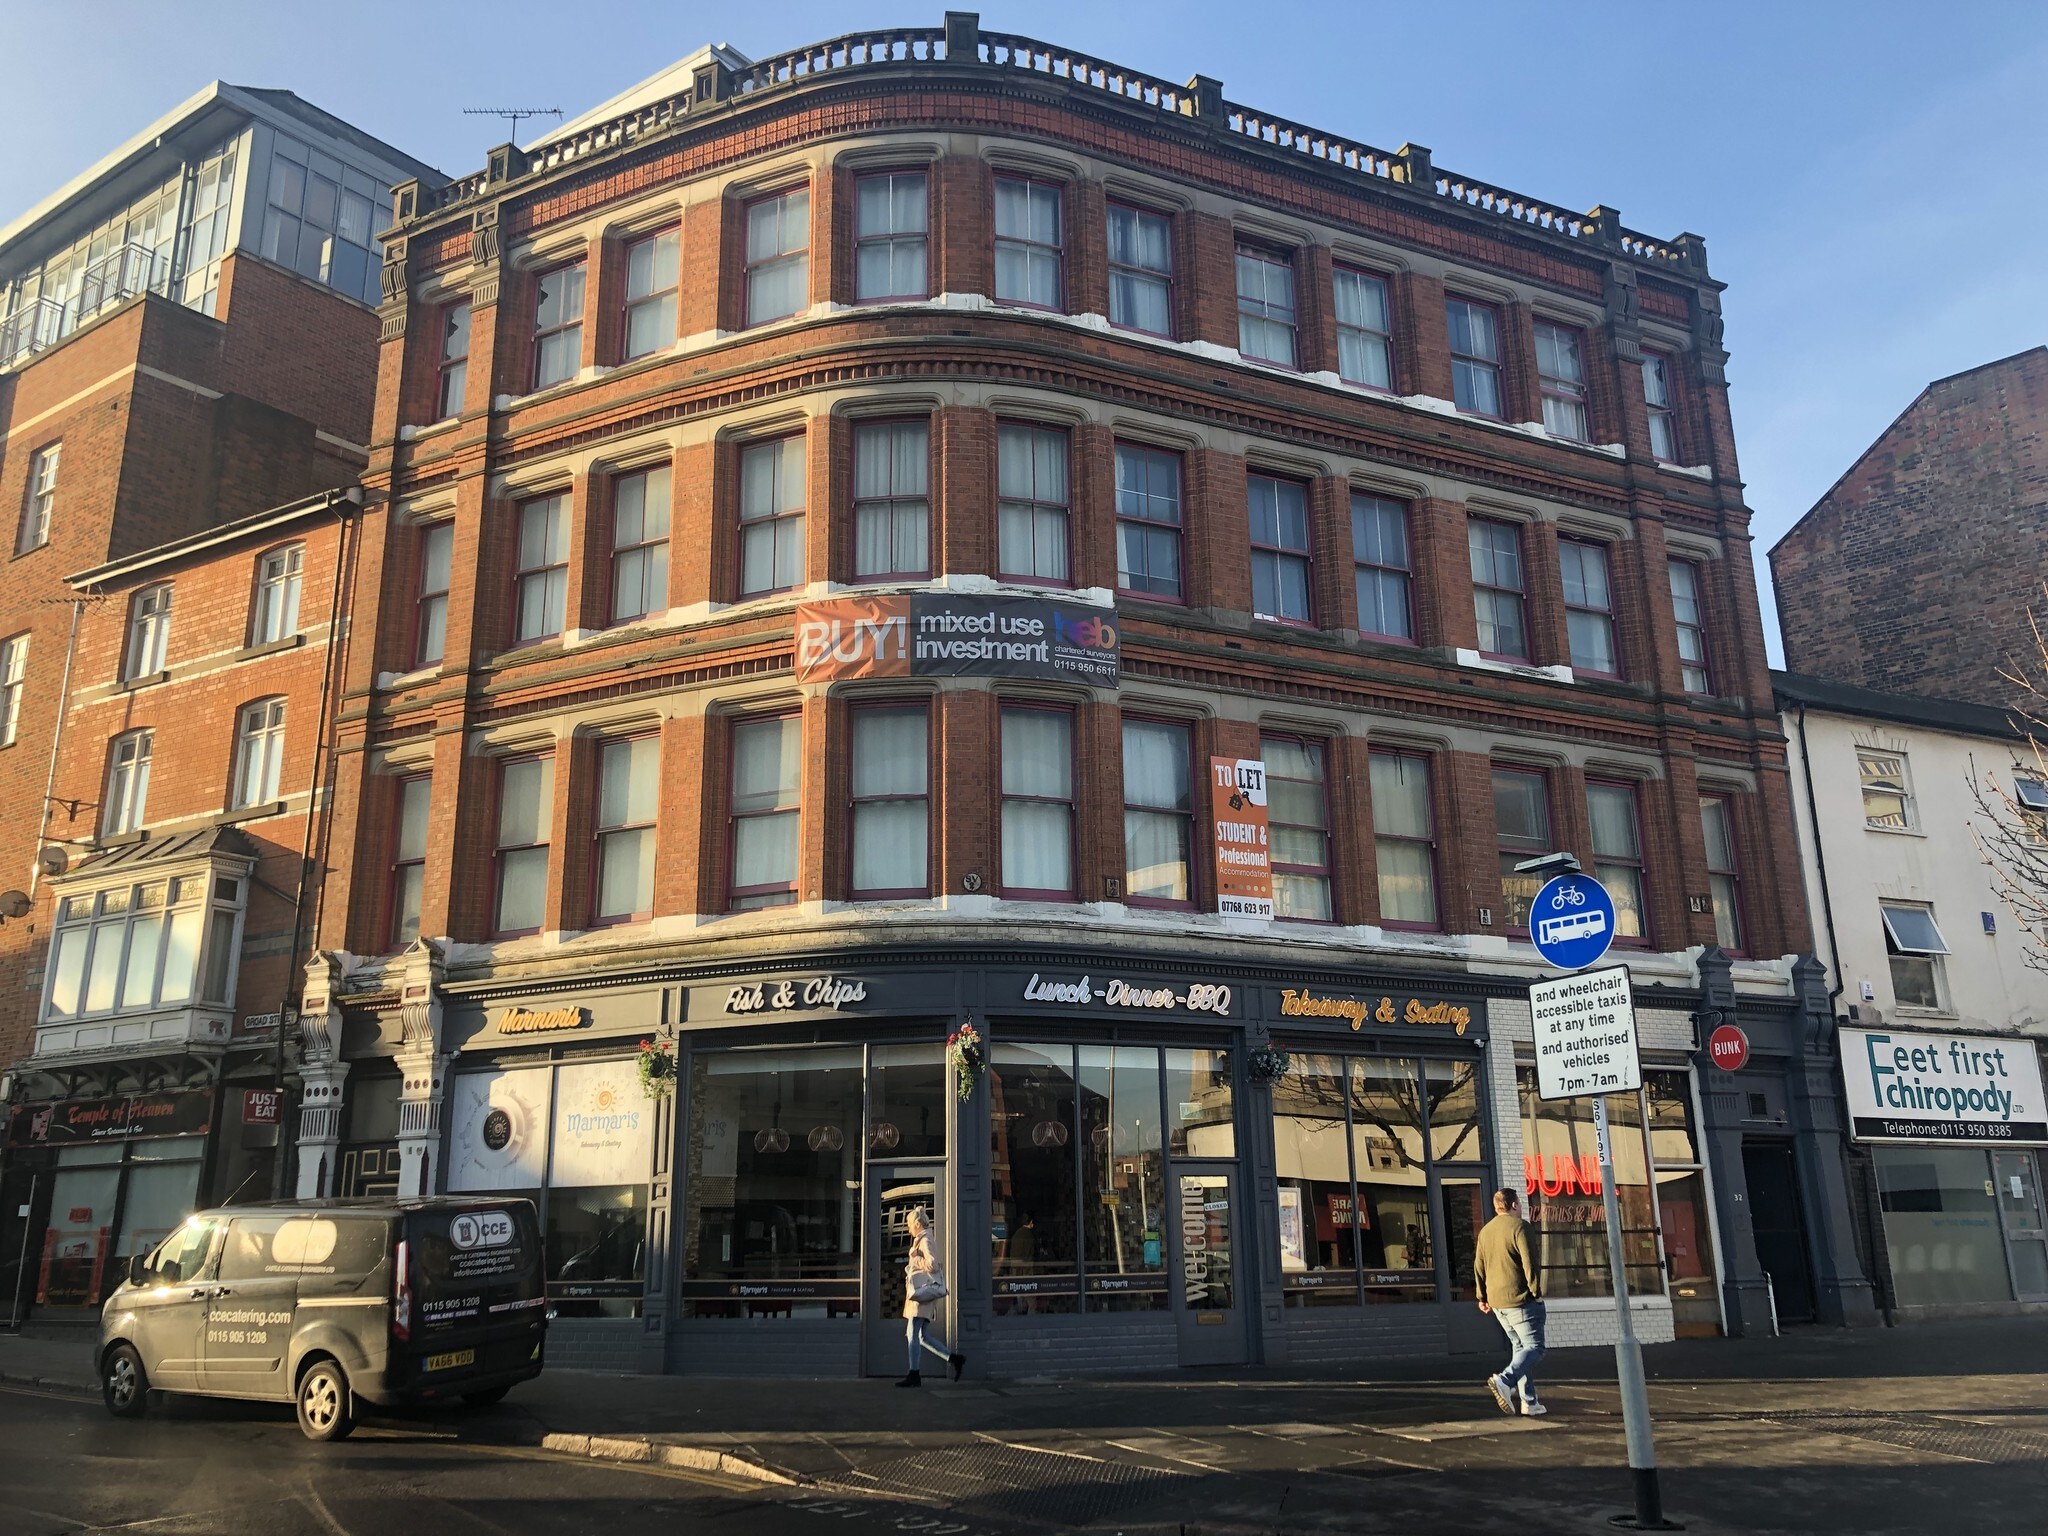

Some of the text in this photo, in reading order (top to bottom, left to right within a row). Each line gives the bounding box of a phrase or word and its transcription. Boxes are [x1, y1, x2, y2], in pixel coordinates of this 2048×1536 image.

[920, 610, 1044, 636] mixed use
[1053, 611, 1116, 650] heb
[799, 615, 907, 667] BUY!
[916, 635, 1049, 663] investment
[1054, 645, 1117, 660] chartered surveyors
[1054, 660, 1116, 677] 0115 950 6611
[1215, 764, 1262, 790] TO LET
[1217, 820, 1267, 846] STUDENT &
[1218, 846, 1267, 867] Professional
[1219, 866, 1269, 879] Accommodation
[1221, 900, 1270, 915] 07768 623 917
[723, 976, 868, 1013] Fish & Chips
[1023, 973, 1092, 1004] Lunch
[1105, 979, 1176, 1009] Dinner
[1186, 983, 1231, 1016] BBQ
[1535, 974, 1622, 1003] and wheelchair
[1280, 988, 1469, 1036] Takeaway & Seating
[1535, 992, 1627, 1020] accessible taxis
[245, 1016, 268, 1027] BROAD
[496, 1004, 582, 1035] Marmaris
[1550, 1012, 1615, 1034] at any time
[1541, 1029, 1629, 1056] and authorised
[1714, 1040, 1742, 1056] BUNK
[1562, 1053, 1611, 1070] vehicles
[1864, 1033, 2008, 1108] Feet first
[249, 1093, 278, 1106] JUST
[1886, 1075, 2025, 1121] chiropody LTD
[67, 1099, 176, 1126] Temple of Heaven
[255, 1105, 277, 1118] EAT
[566, 1110, 640, 1139] Marmaris
[1967, 1124, 1986, 1136] 950
[1988, 1124, 2012, 1137] 8385
[1205, 1202, 1228, 1211] CLOSED
[1733, 1193, 1743, 1202] 32
[481, 1222, 507, 1236] CCE
[454, 1264, 515, 1278] info@ccecatering.com
[459, 1256, 510, 1268] ccecatering.com
[740, 1285, 768, 1296] Marmaris
[1009, 1281, 1038, 1292] Marmaris
[1101, 1279, 1128, 1289] Marmaris
[422, 1300, 445, 1312] 0115
[461, 1296, 480, 1308] 1208
[209, 1308, 291, 1327] ccecatering.com
[207, 1329, 268, 1344] 0115 905 1208
